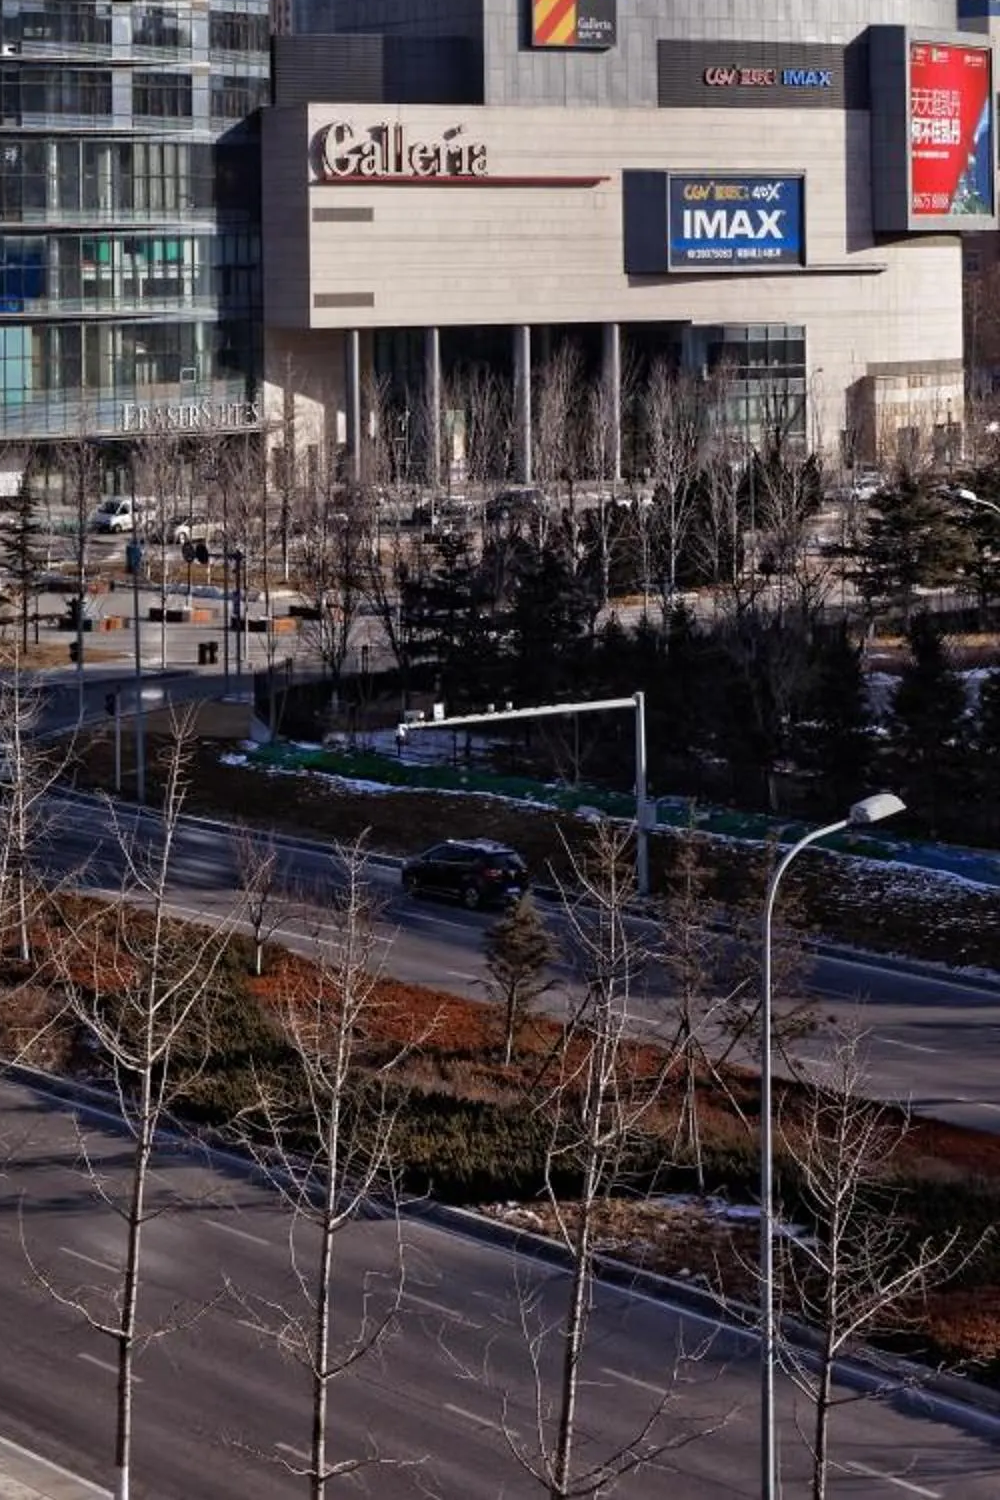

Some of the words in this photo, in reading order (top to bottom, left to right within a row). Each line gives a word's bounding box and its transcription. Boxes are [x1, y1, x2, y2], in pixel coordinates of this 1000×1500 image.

[783, 67, 833, 85] IMAX
[323, 118, 490, 177] Galleria
[683, 209, 783, 239] IMAX
